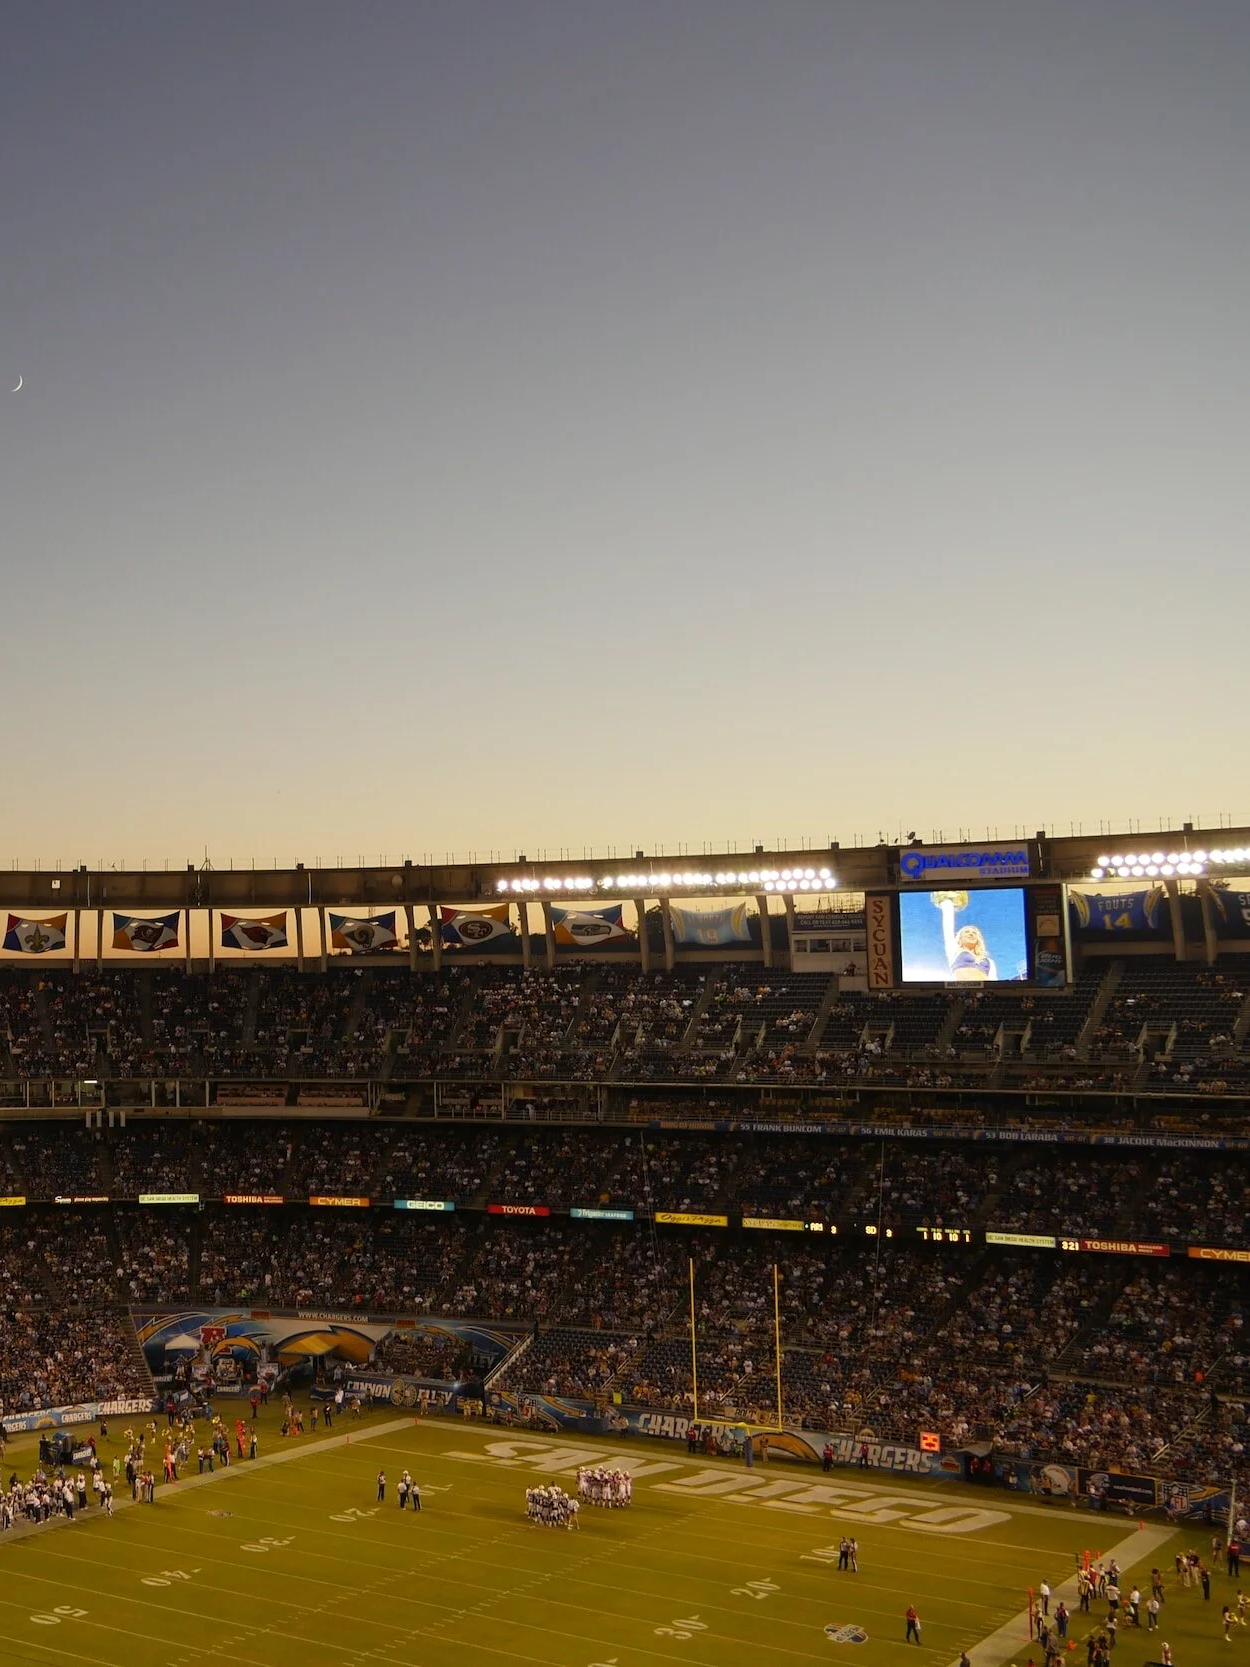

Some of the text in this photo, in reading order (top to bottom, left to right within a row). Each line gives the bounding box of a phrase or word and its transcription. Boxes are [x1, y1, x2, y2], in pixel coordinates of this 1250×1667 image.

[900, 852, 1028, 879] QUALCOMM
[979, 866, 1030, 876] STADIUM
[1097, 898, 1134, 912] FOUTS
[1102, 912, 1133, 930] 14
[872, 900, 889, 985] SYCUAN
[740, 1123, 750, 1131] 55
[752, 1124, 782, 1133] FRANK
[783, 1125, 822, 1134] BUNCOM
[874, 1129, 896, 1137] EMIL
[897, 1129, 928, 1138] KARAS
[999, 1132, 1018, 1140] BOB
[1020, 1133, 1058, 1142] LARABA
[1117, 1137, 1155, 1146] JACQUE
[1156, 1138, 1220, 1149] MacKINNON
[225, 1195, 263, 1203] TOSHIBA
[317, 1197, 361, 1206] CYMER
[406, 1200, 445, 1210] GEICO
[501, 1205, 536, 1215] TOYOTA
[1085, 1240, 1137, 1253] TOSHIBA
[1200, 1250, 1250, 1263] CYME
[297, 1311, 369, 1323] WWW.CHARGERS.COM
[216, 1385, 240, 1393] CHARGERS
[96, 1398, 153, 1415] CHARGERS
[61, 1411, 93, 1424] CHARGERS
[828, 1438, 935, 1474] CHARGERS
[650, 1470, 1012, 1533] DIEGO
[329, 1508, 376, 1522] 20
[240, 1536, 291, 1553] 30
[140, 1569, 192, 1587] 40
[730, 1580, 782, 1600] 20
[29, 1604, 90, 1625] 50
[653, 1619, 709, 1640] 30
